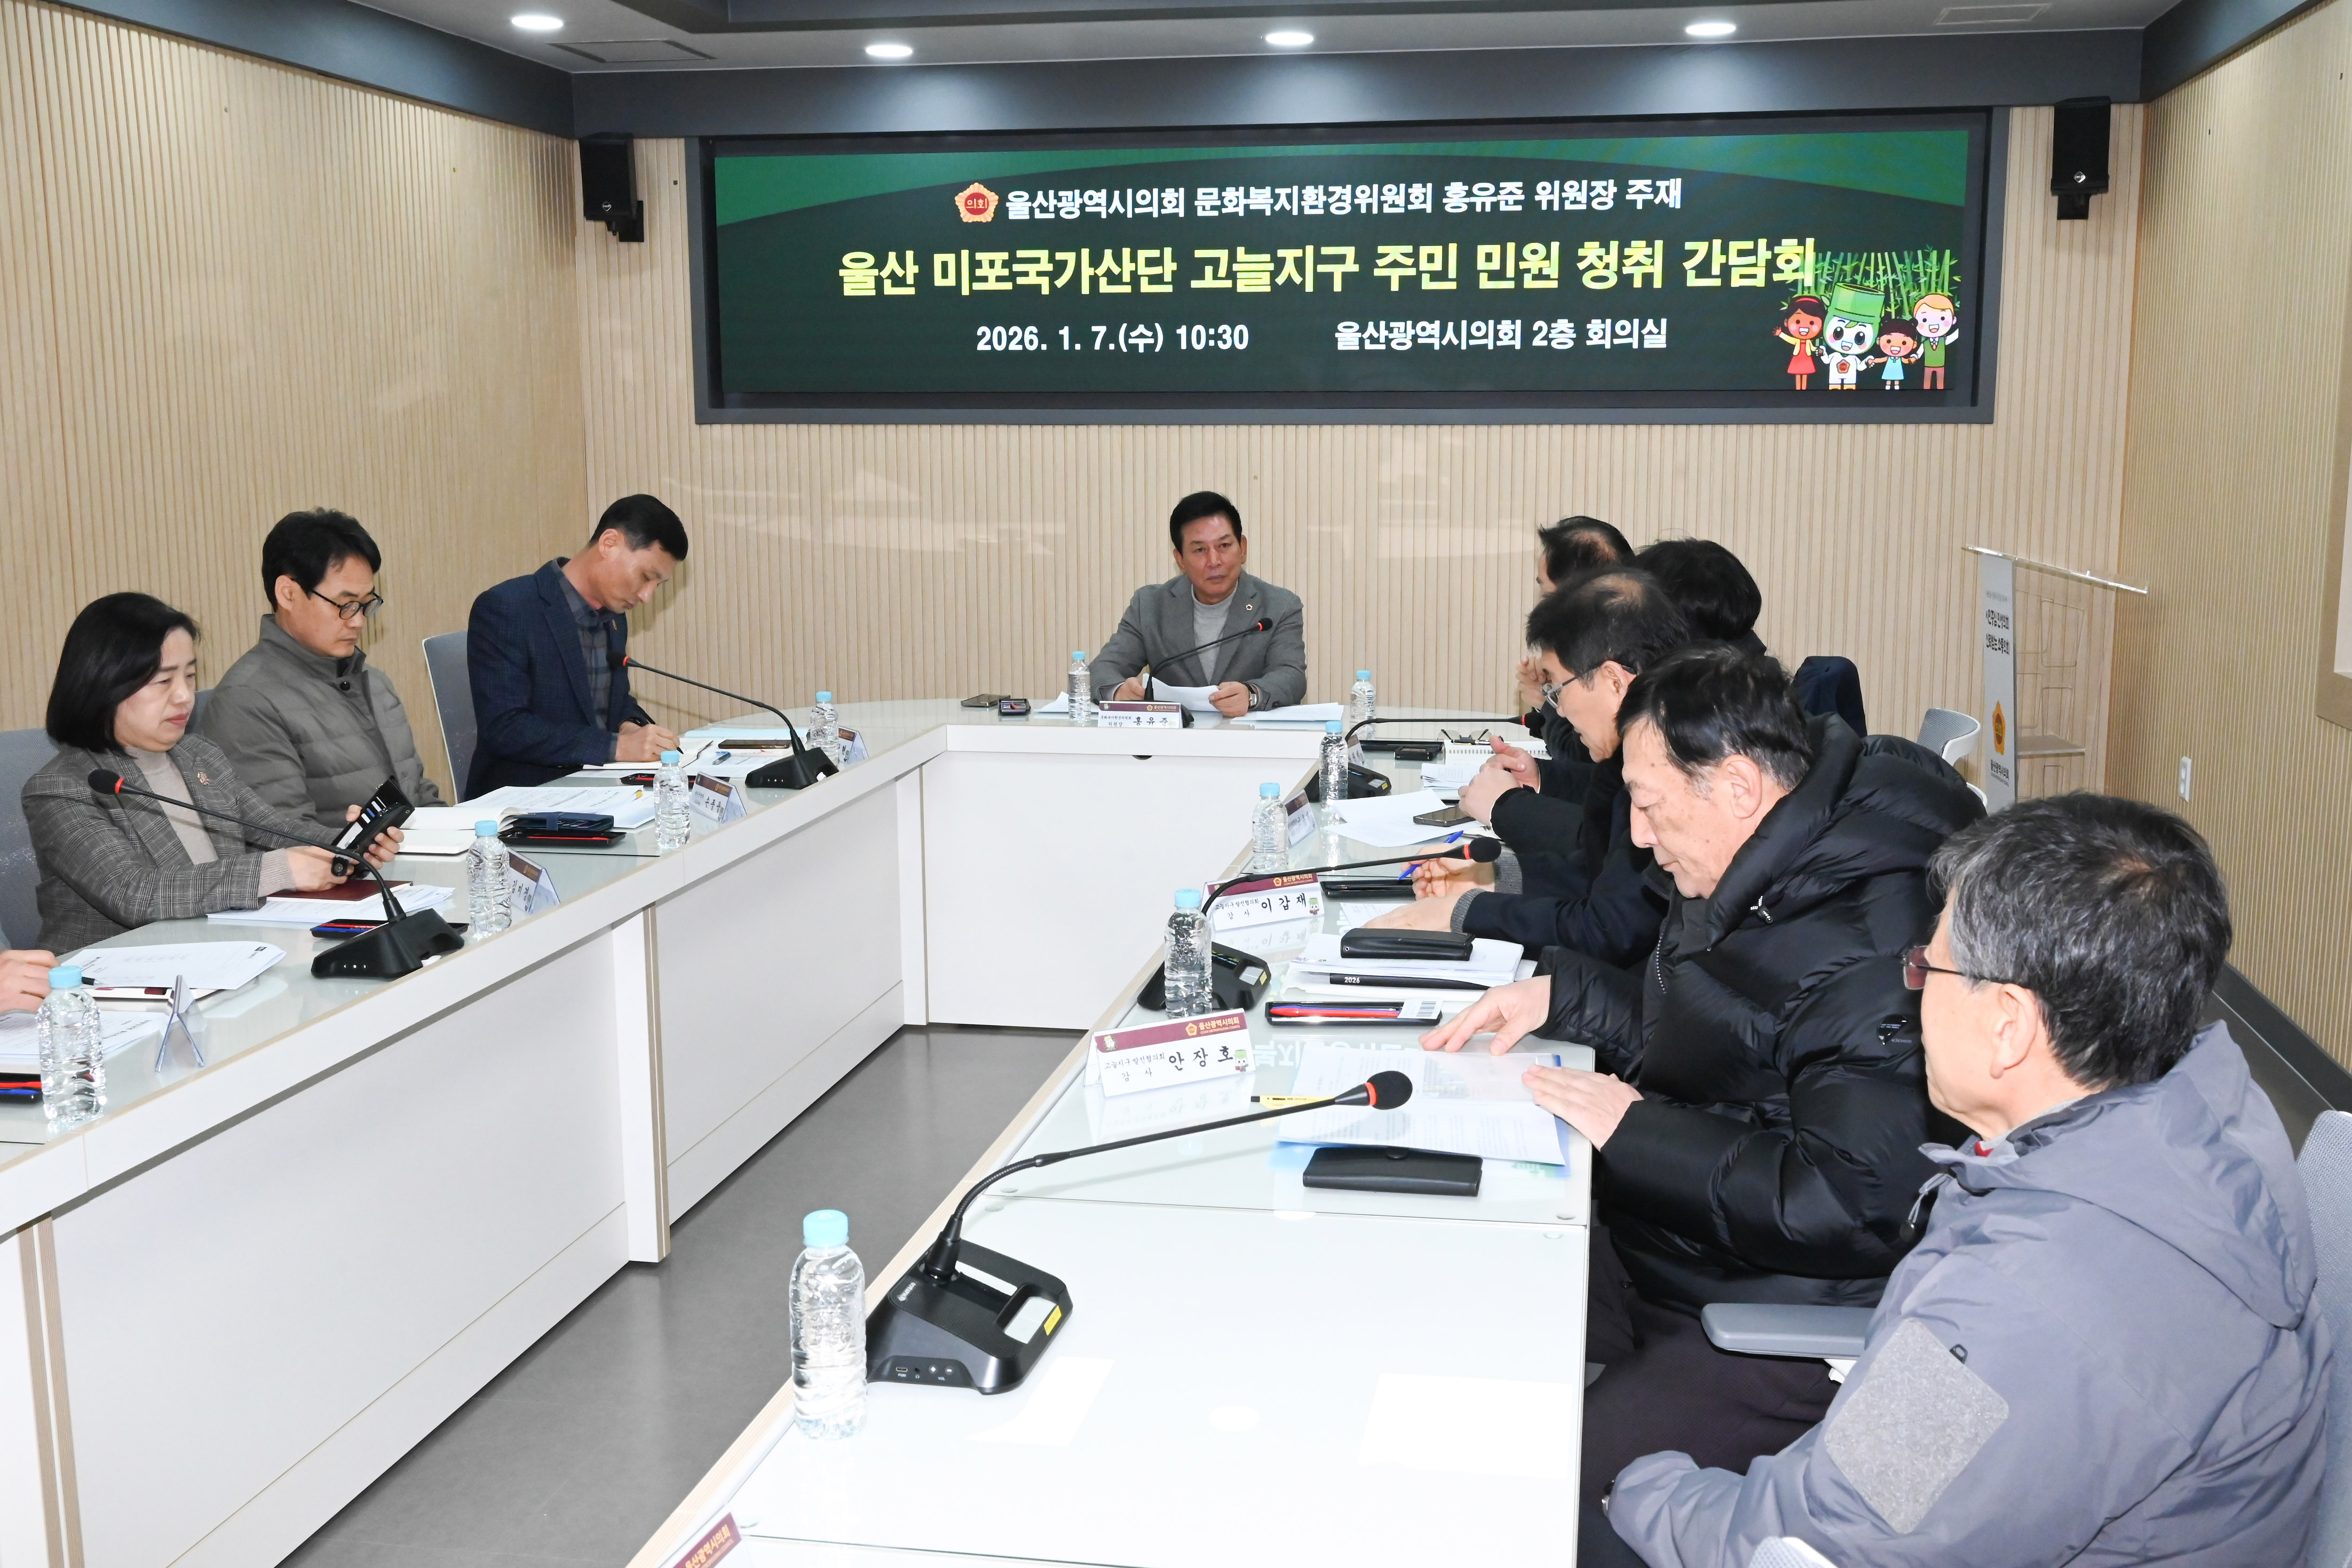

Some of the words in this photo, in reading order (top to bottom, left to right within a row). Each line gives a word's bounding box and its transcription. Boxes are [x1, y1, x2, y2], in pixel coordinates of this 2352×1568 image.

[965, 198, 987, 209] 의회
[1006, 188, 1184, 219] 울산광역시의회
[1194, 183, 1432, 216] 문화복지환경위원회
[1443, 182, 1525, 212] 홍유준
[1535, 179, 1617, 210] 위원장
[1626, 178, 1681, 209] 주재
[839, 250, 918, 296] 울산
[934, 248, 1177, 295] 미포국가산단
[1191, 246, 1359, 292] 고늘지구
[1374, 243, 1457, 291] 주민
[1477, 242, 1559, 289] 민원
[1577, 240, 1664, 289] 청취
[1682, 237, 1815, 287] 간담회
[977, 326, 1047, 351] 2026.
[1059, 326, 1080, 350] 1.
[1091, 323, 1163, 353] 7.(수)
[1176, 324, 1248, 350] 10:30
[1335, 320, 1521, 350] 울산광역시의회
[1532, 319, 1576, 349] 2층
[1586, 319, 1667, 349] 회의실
[1261, 893, 1306, 913] 이갑재
[1199, 1016, 1240, 1030] 울산광역시의회
[1169, 1046, 1234, 1071] 안장호
